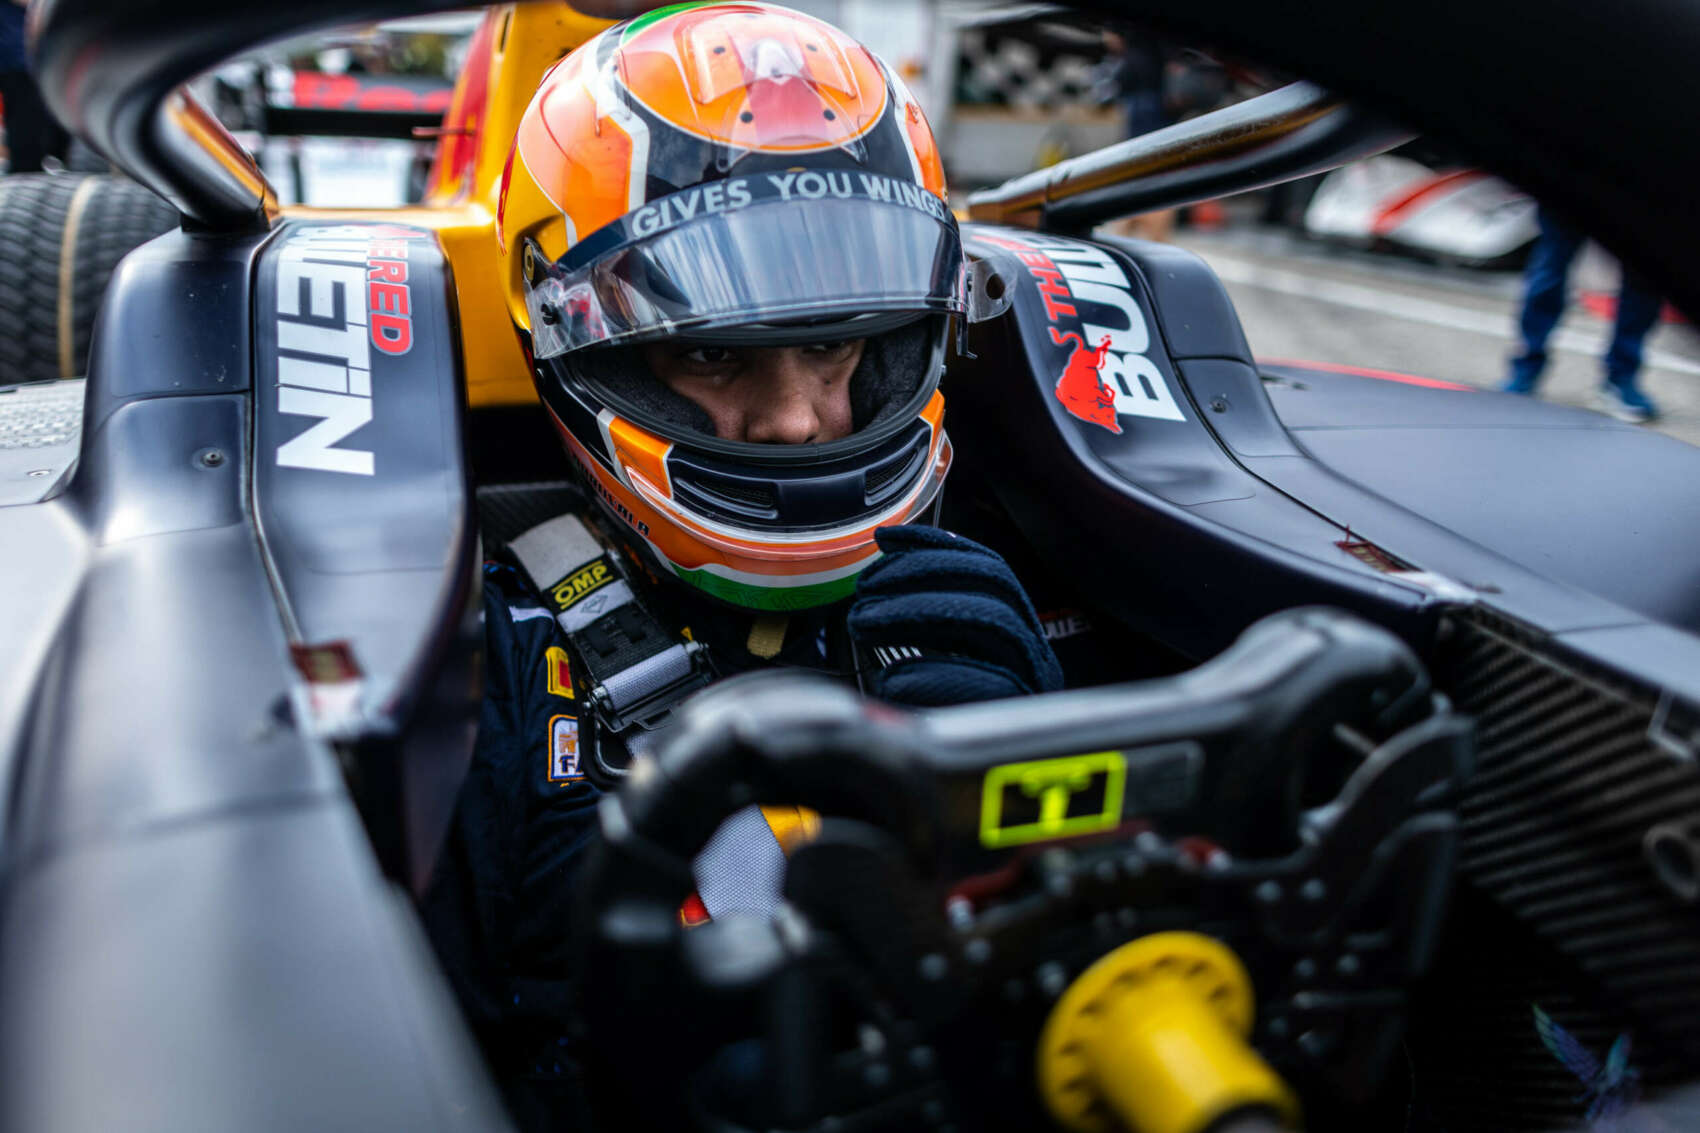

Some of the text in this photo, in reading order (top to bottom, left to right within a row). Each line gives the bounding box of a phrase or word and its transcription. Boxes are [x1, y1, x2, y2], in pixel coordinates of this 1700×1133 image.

[631, 171, 946, 238] GIVES YOU WINGS
[553, 564, 608, 604] OMP
